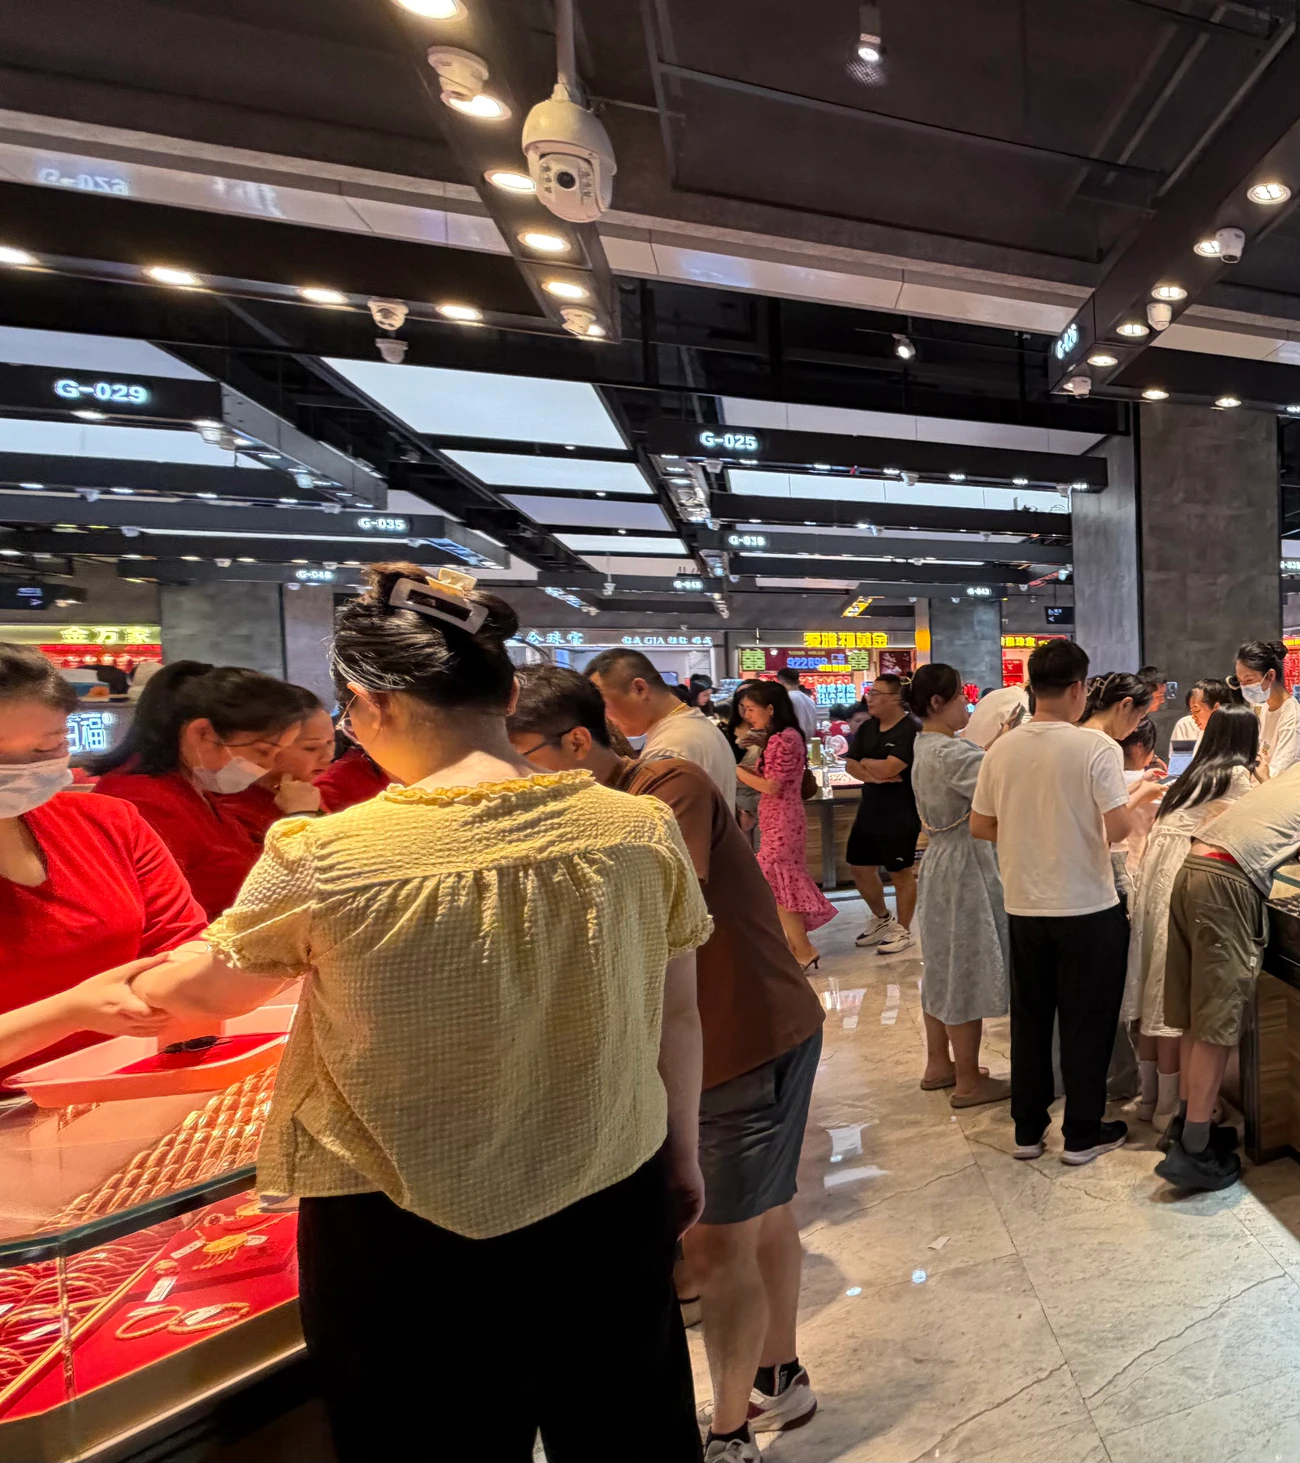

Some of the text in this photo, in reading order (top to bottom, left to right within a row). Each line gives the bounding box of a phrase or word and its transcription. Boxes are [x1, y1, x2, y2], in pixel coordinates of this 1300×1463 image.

[54, 379, 149, 405] G-029
[700, 431, 759, 450] G-025
[358, 517, 407, 531] G-035
[60, 625, 152, 643] 金万家
